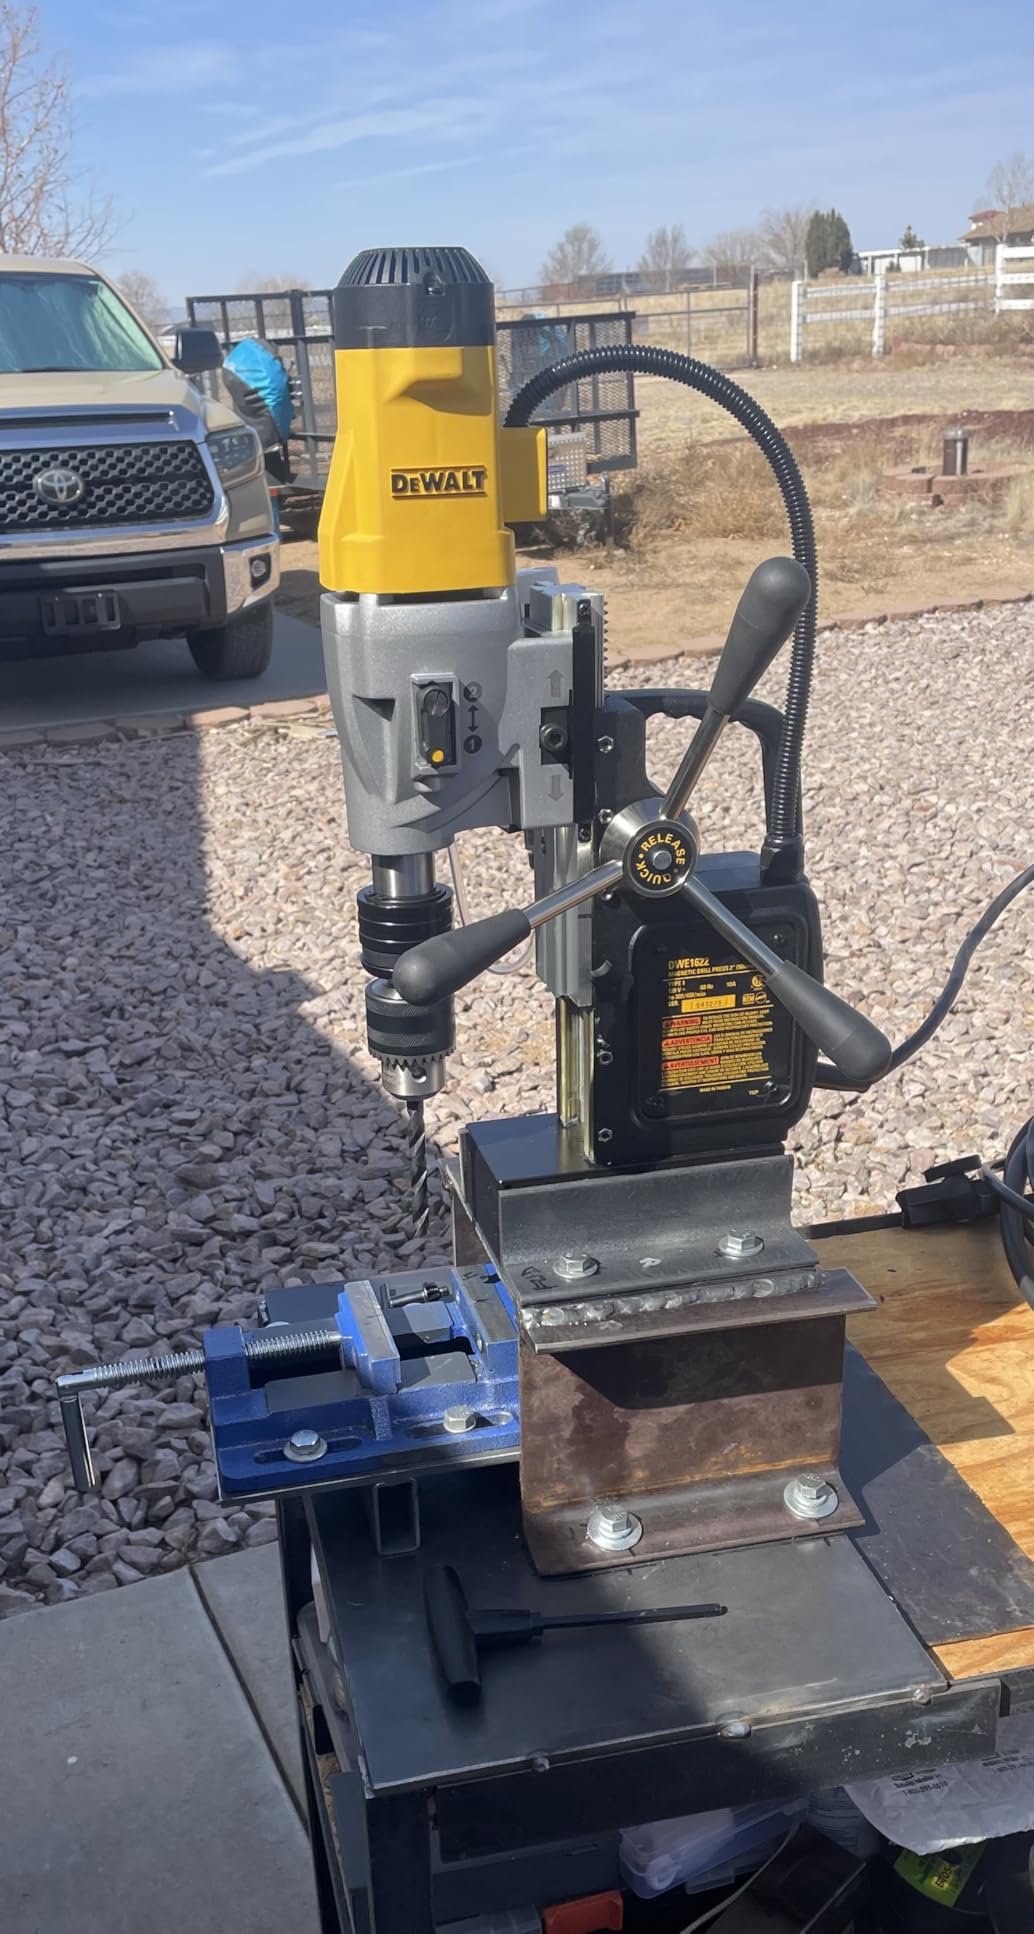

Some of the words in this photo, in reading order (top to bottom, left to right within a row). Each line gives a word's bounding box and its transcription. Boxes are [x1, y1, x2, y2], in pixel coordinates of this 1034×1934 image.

[640, 833, 686, 865] RELEASE
[635, 860, 672, 885] QUICK
[668, 957, 710, 970] DWE1622
[670, 1017, 700, 1028] WARNING
[670, 1036, 711, 1046] ADVERTENCIA
[669, 1057, 718, 1068] AVERTISSEMENT
